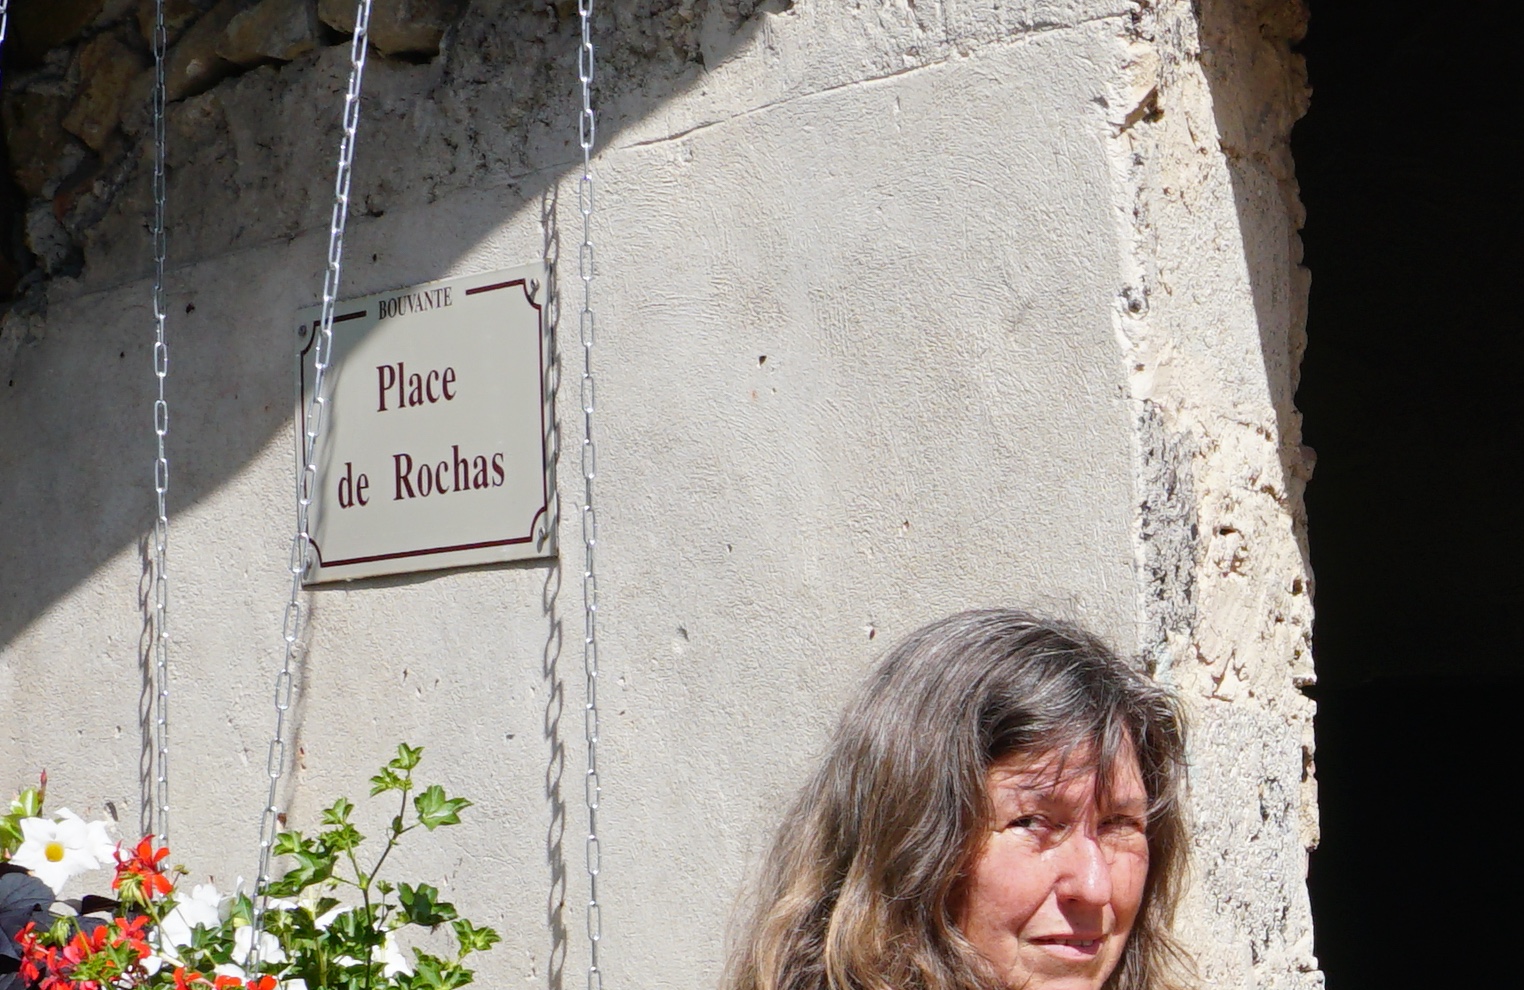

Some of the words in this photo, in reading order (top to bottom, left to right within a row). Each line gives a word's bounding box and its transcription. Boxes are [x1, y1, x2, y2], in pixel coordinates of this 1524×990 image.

[379, 287, 452, 319] BOUVANTE
[376, 362, 456, 411] Place
[338, 462, 369, 509] de
[393, 445, 505, 500] Rochas
